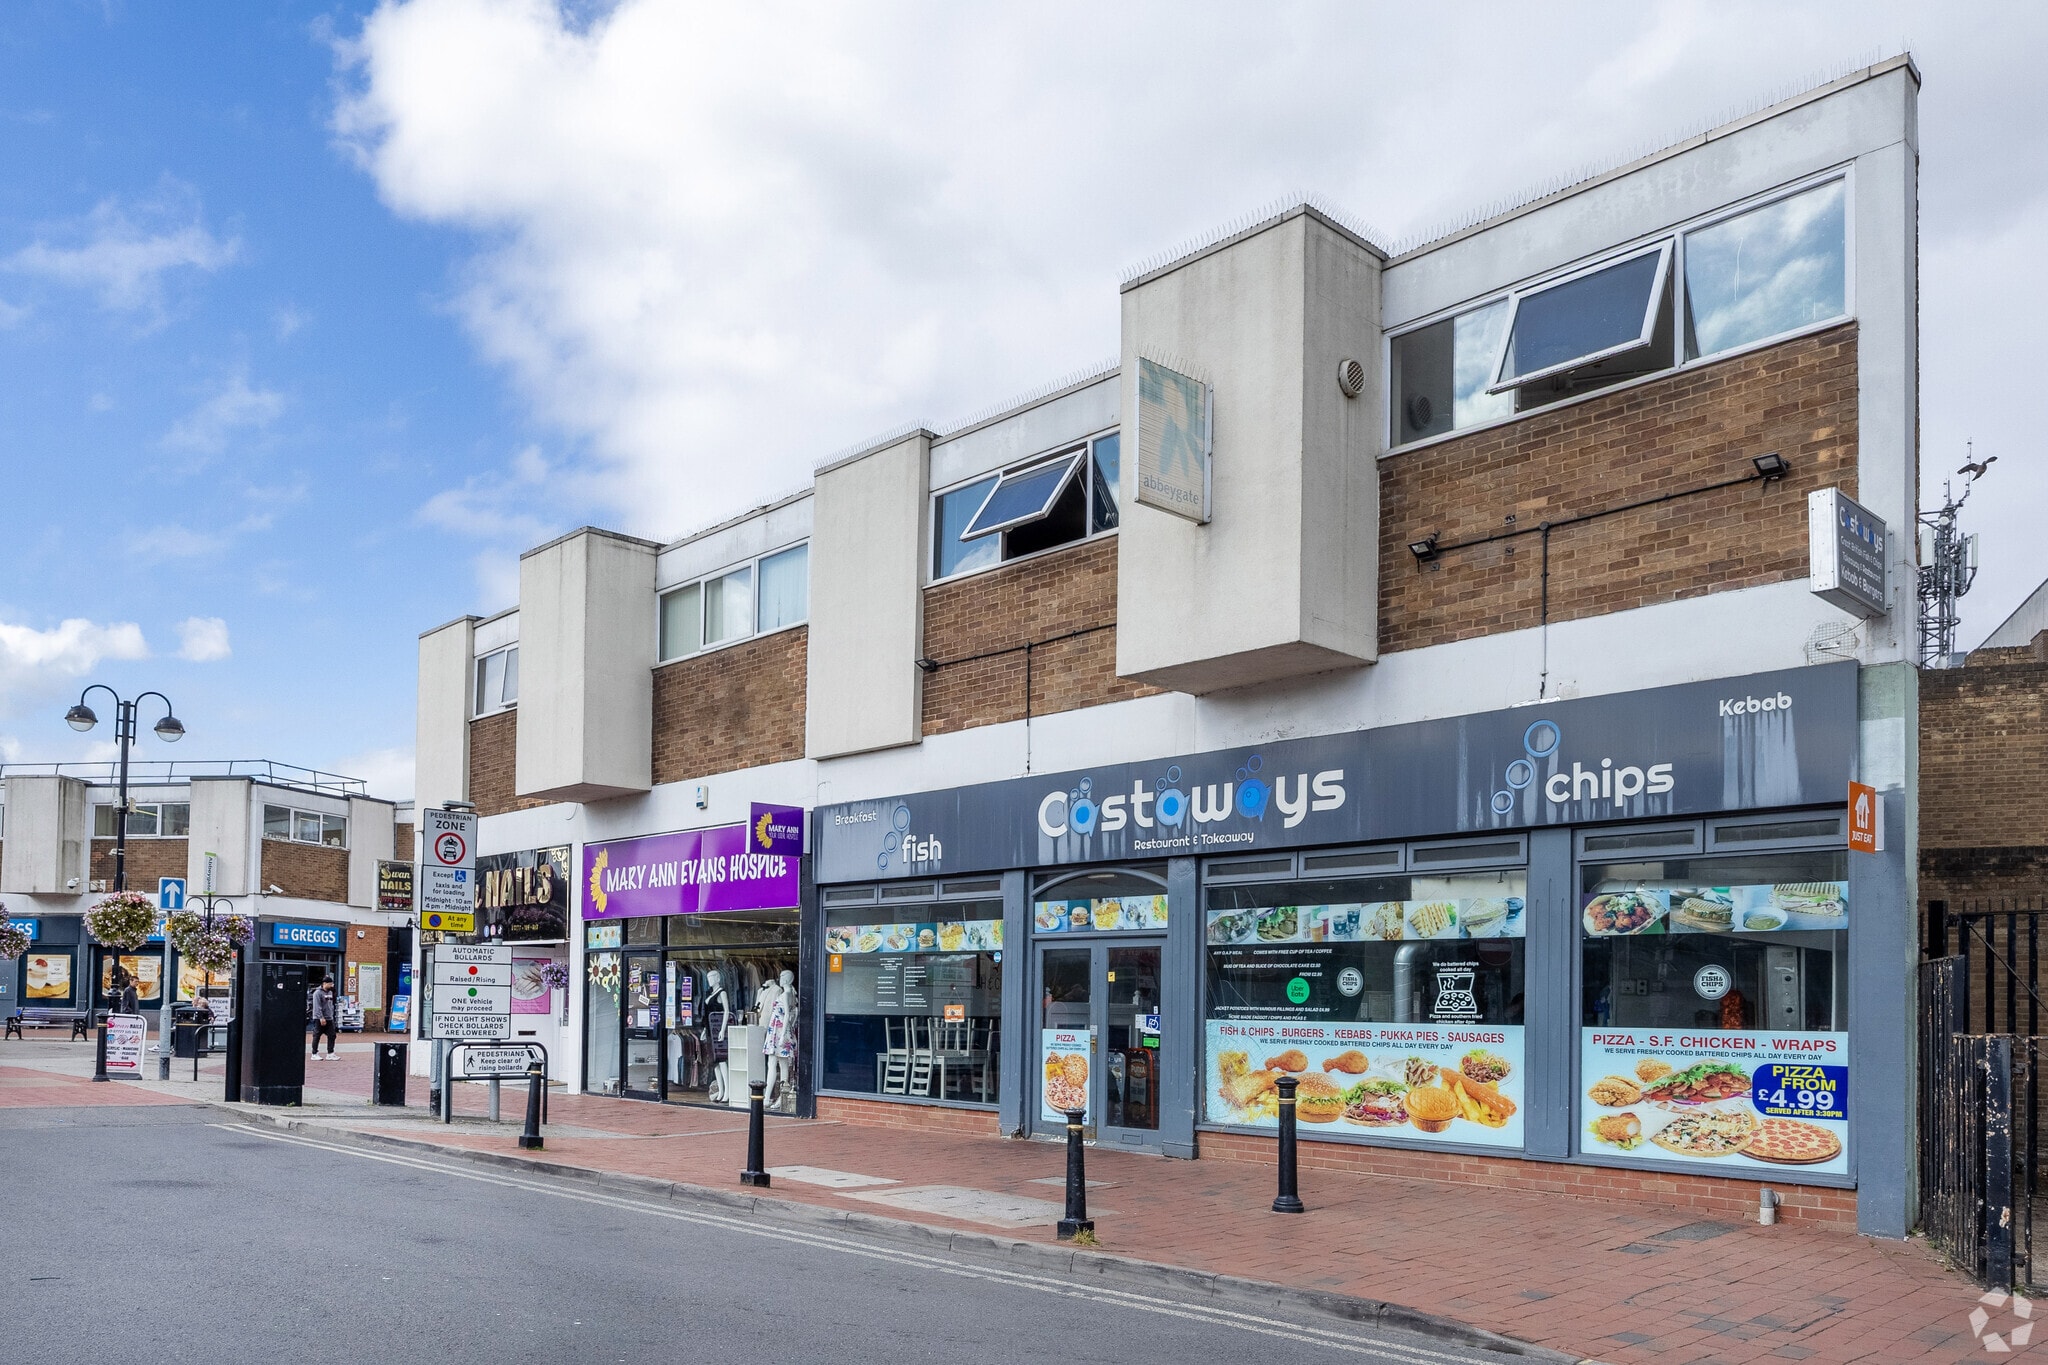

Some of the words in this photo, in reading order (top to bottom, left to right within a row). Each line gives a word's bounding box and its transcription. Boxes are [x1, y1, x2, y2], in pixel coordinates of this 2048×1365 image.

[1143, 475, 1199, 504] abbeygate
[1840, 506, 1883, 553] Castaways
[1862, 578, 1882, 602] Burgers
[1719, 692, 1792, 717] Kebab
[1545, 758, 1675, 807] chips
[1037, 768, 1347, 838] Castaways
[430, 812, 472, 822] PEDESTRIAN
[835, 810, 877, 826] Breakfast
[436, 820, 466, 831] ZONE
[768, 824, 786, 833] MARY
[786, 826, 799, 834] ANN
[1134, 835, 1190, 850] Restaurant
[1192, 835, 1198, 845] &
[1201, 832, 1254, 844] Takeaway
[1852, 830, 1863, 842] JUST
[1864, 833, 1872, 844] EAT
[901, 833, 942, 863] fish
[381, 867, 410, 879] Swan
[432, 871, 454, 879] Except
[606, 864, 646, 893] MARY
[648, 860, 678, 888] ANN
[681, 855, 726, 885] EVANS
[730, 854, 786, 882] HOSPICE
[380, 880, 411, 890] NAILS
[486, 864, 553, 908] NAILS
[291, 928, 336, 944] GREGGS
[1056, 1034, 1076, 1042] PIZZA
[1220, 1027, 1238, 1035] FISH
[1240, 1027, 1246, 1035] &
[1248, 1027, 1274, 1036] CHIPS
[1282, 1028, 1324, 1038] BURGERS
[1335, 1030, 1372, 1039] KEBABS
[1380, 1031, 1413, 1040] PUKKA
[1416, 1031, 1438, 1041] PIES
[1448, 1032, 1504, 1043] SAUSAGES
[1593, 1034, 1635, 1046] PIZZA
[1650, 1036, 1674, 1047] S.F.
[1680, 1036, 1755, 1049] CHICKEN
[1772, 1039, 1836, 1052] WRAPS
[1772, 1065, 1826, 1079] PIZZA
[1781, 1077, 1836, 1091] FROM
[1758, 1089, 1834, 1110] £4.99
